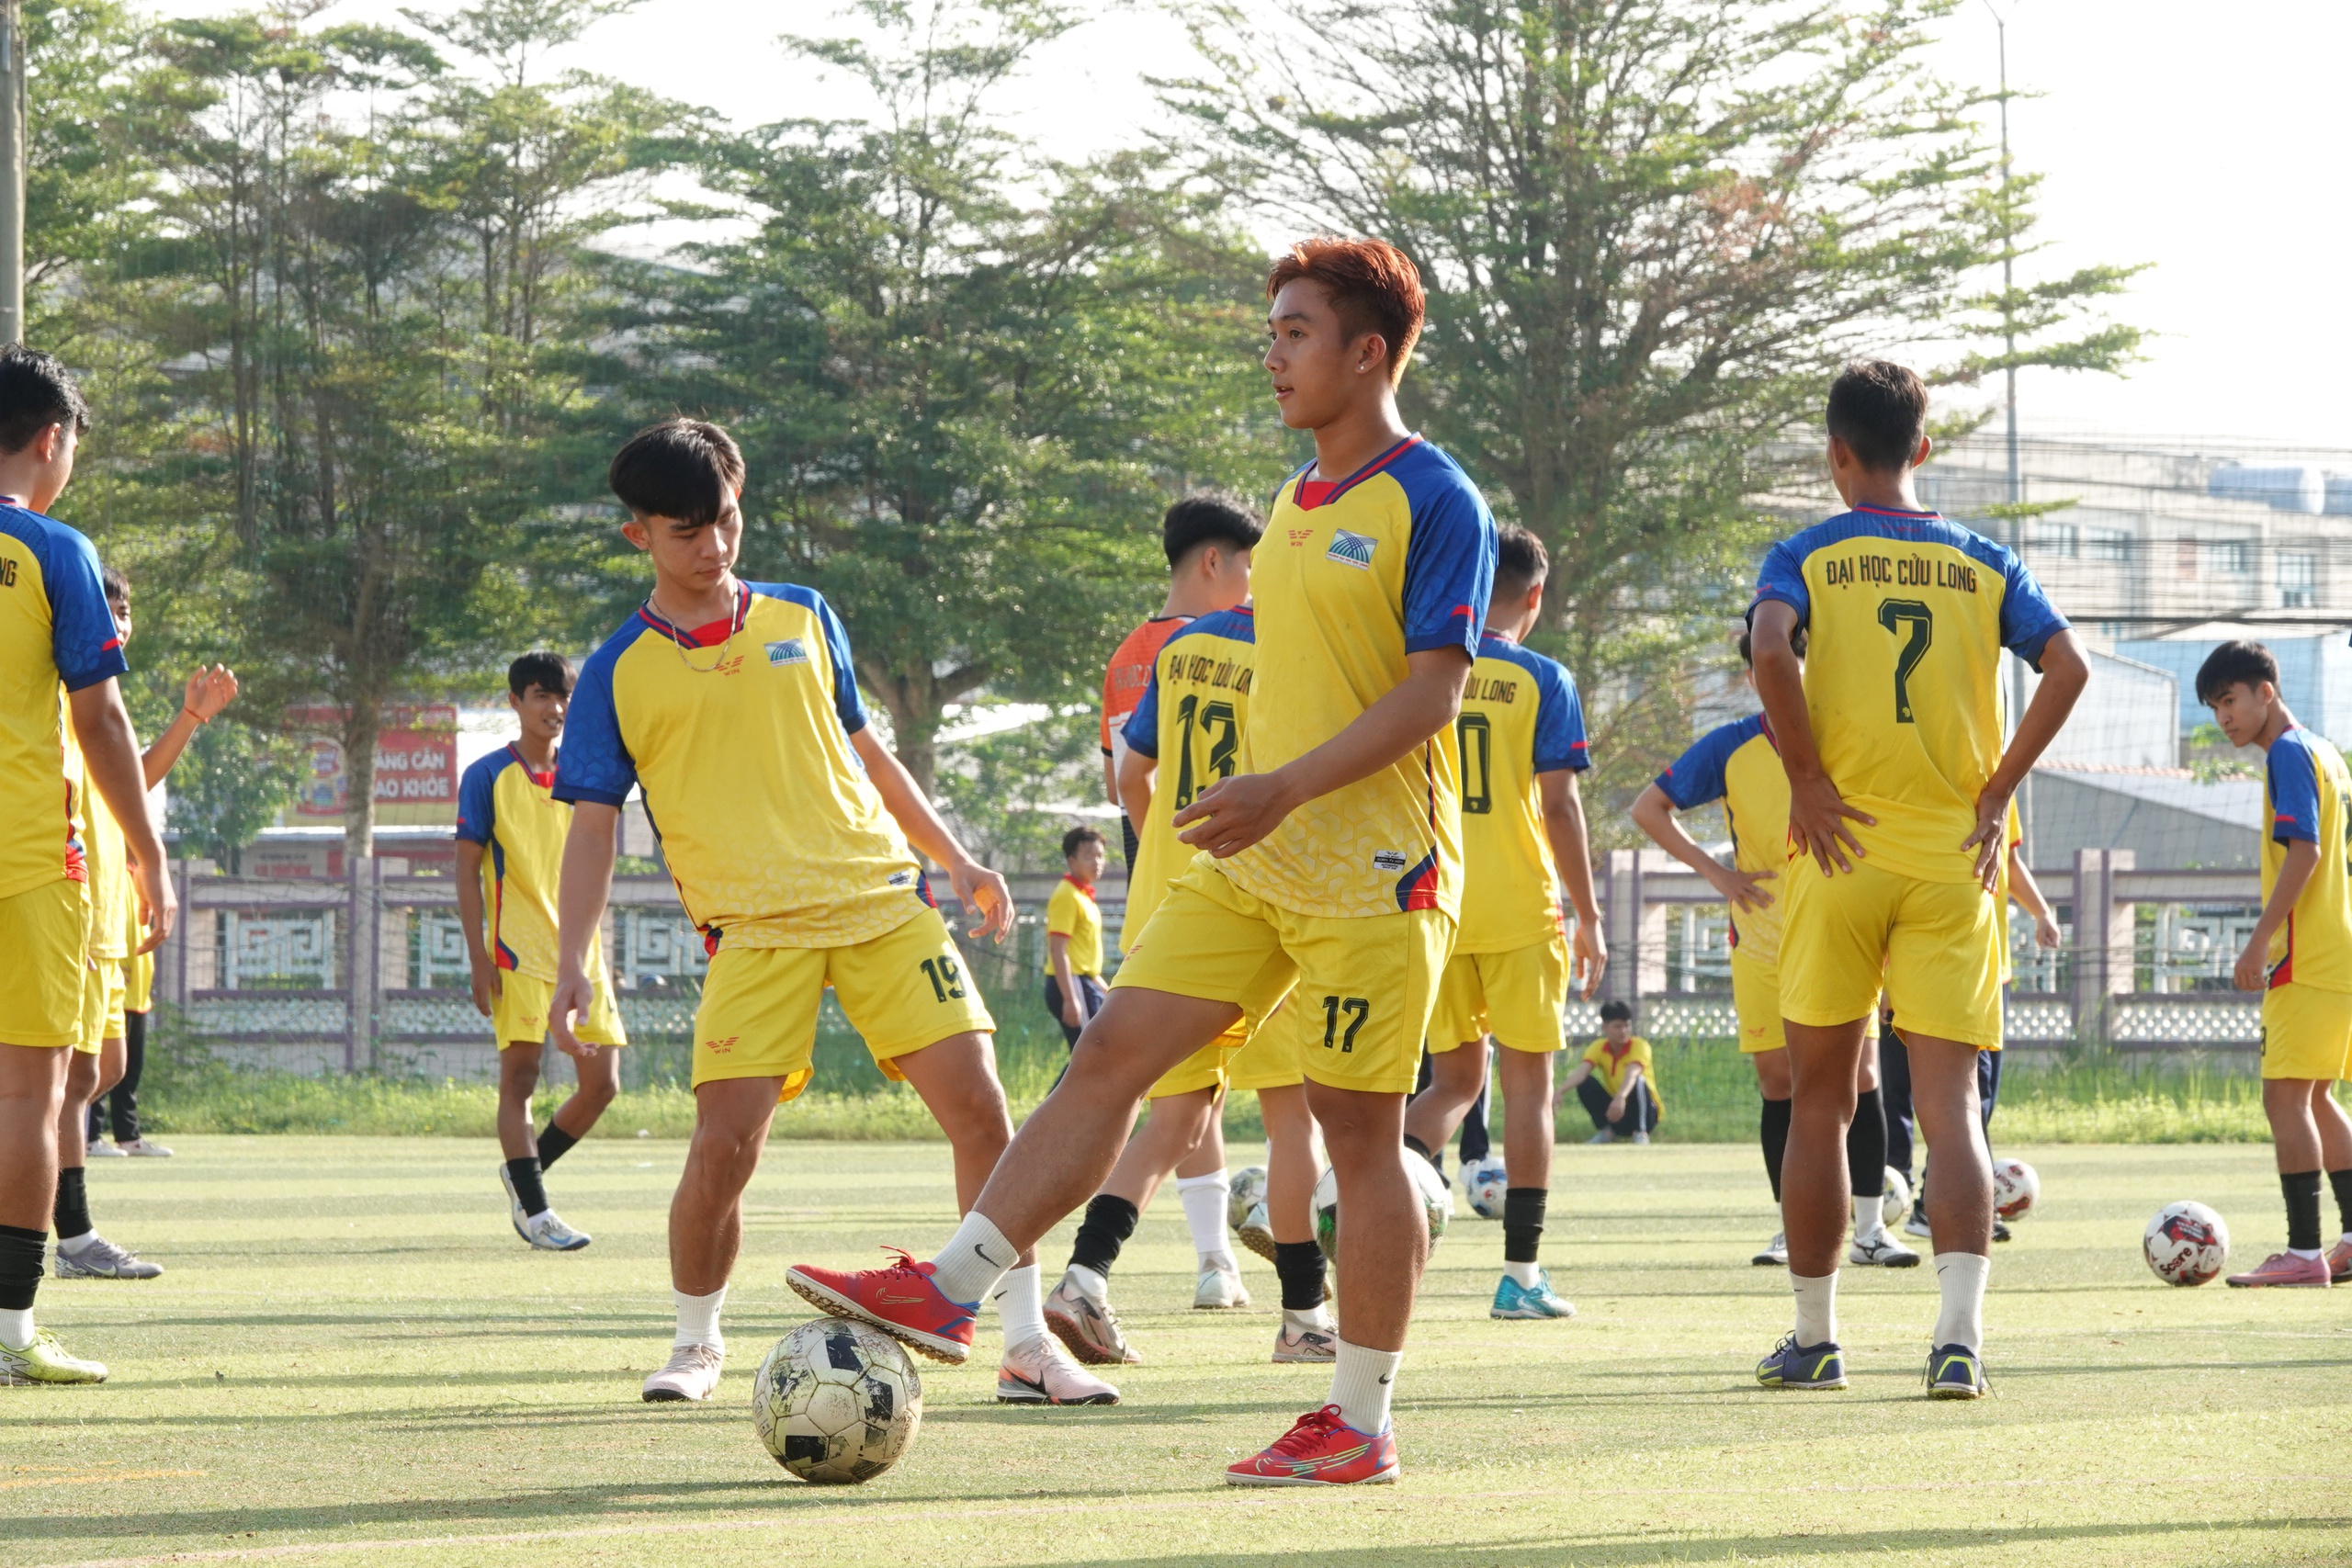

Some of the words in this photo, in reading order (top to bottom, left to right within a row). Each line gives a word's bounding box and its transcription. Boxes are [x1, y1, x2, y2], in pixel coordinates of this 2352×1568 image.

[1826, 557, 1854, 590] ĐẠI
[1860, 555, 1892, 589] HỌC
[1897, 553, 1931, 586] CỬU
[1938, 560, 1978, 594] LONG
[1169, 654, 1188, 685] ĐẠI
[1186, 654, 1215, 686] HỌC
[1231, 664, 1253, 696] LON
[1877, 598, 1933, 724] 7
[1481, 678, 1517, 705] LONG
[375, 749, 408, 771] ĂNG
[1175, 694, 1238, 814] 13
[1457, 712, 1492, 814] 0
[375, 777, 399, 799] AO
[920, 955, 967, 1003] 19
[1322, 996, 1369, 1054] 17
[2159, 1247, 2193, 1275] Score
